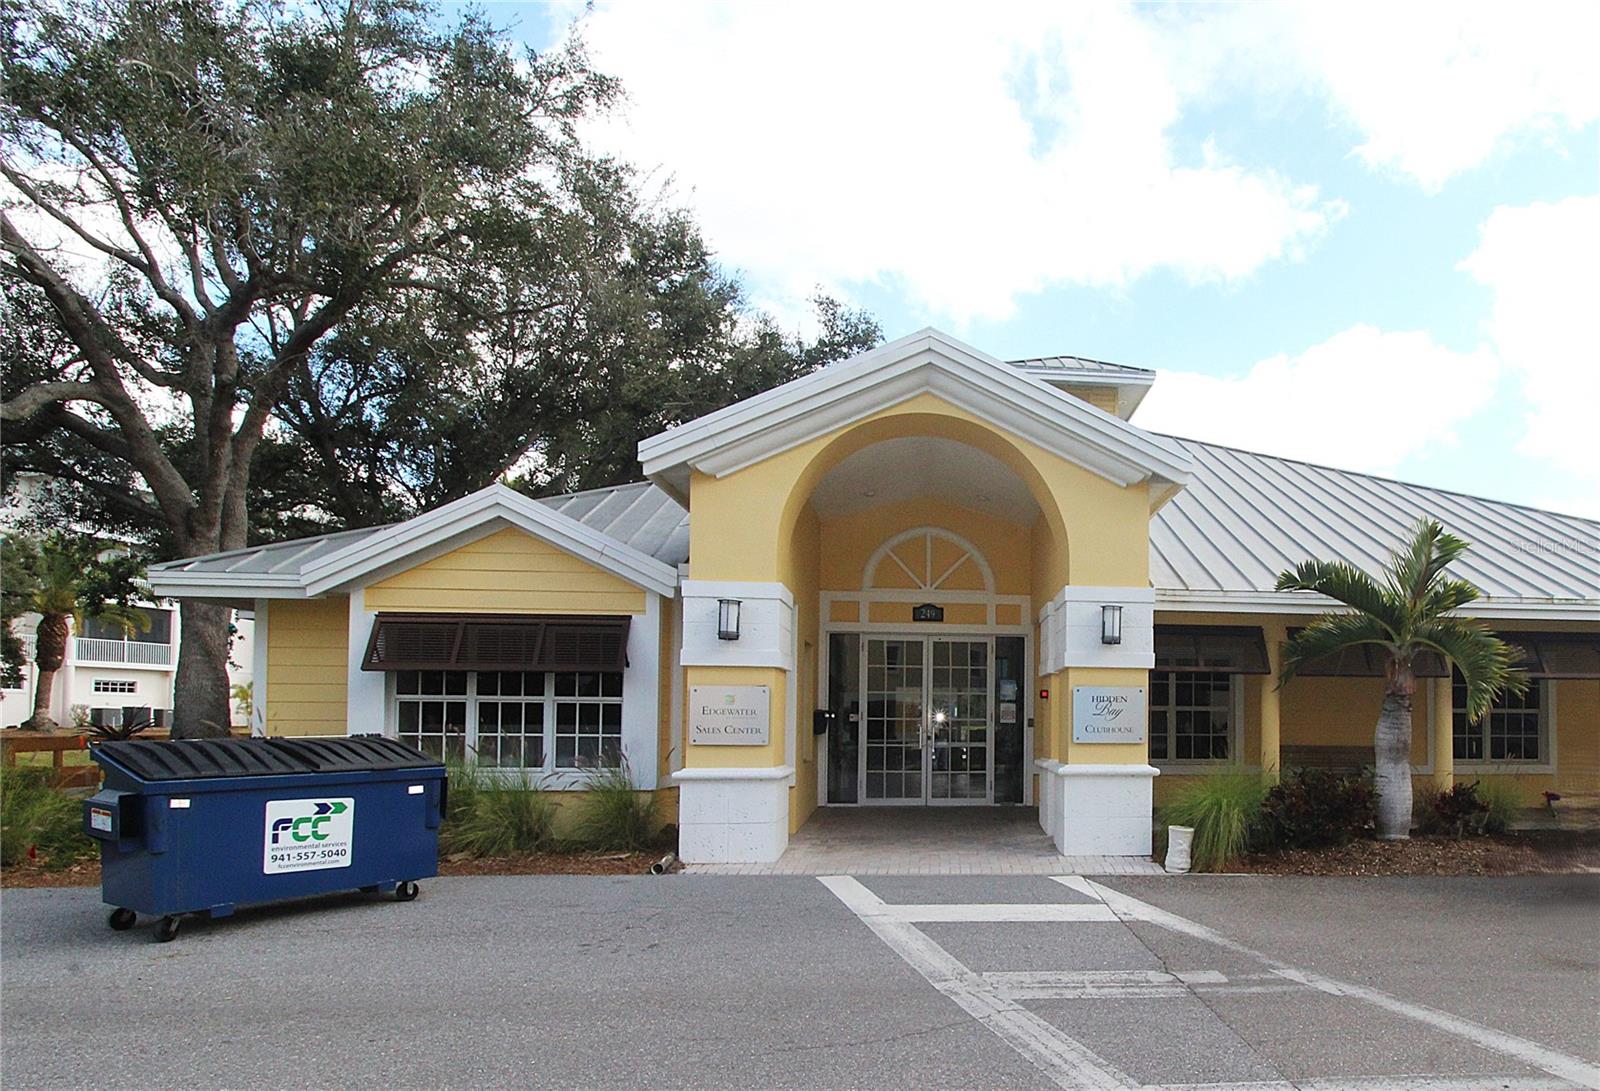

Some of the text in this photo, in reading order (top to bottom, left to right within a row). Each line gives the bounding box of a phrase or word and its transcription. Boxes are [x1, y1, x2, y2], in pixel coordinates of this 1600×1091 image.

[1092, 701, 1124, 721] Bay
[272, 816, 331, 844] FCC
[271, 843, 320, 852] environmental
[271, 848, 347, 863] 941-557-5040
[278, 859, 340, 869] fccenvironmental.com
